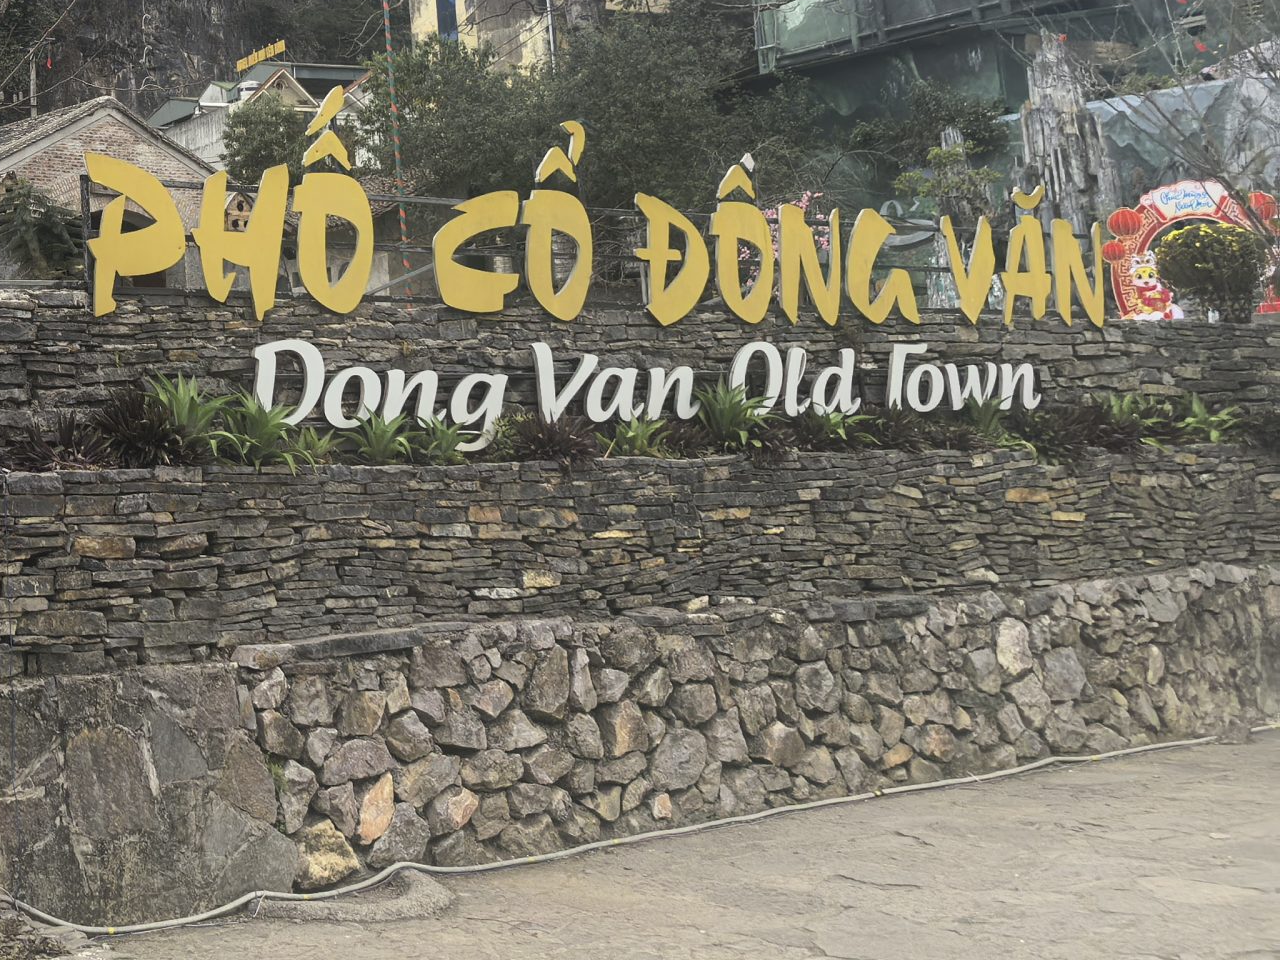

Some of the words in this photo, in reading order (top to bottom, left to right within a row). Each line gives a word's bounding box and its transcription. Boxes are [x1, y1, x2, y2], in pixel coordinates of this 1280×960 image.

[84, 85, 374, 322] PHỐ
[433, 120, 593, 321] CỔ
[939, 184, 1105, 327] VĂN
[253, 339, 508, 451] Dong
[530, 342, 701, 424] Van
[728, 341, 862, 417] Old
[887, 343, 1042, 412] Town
